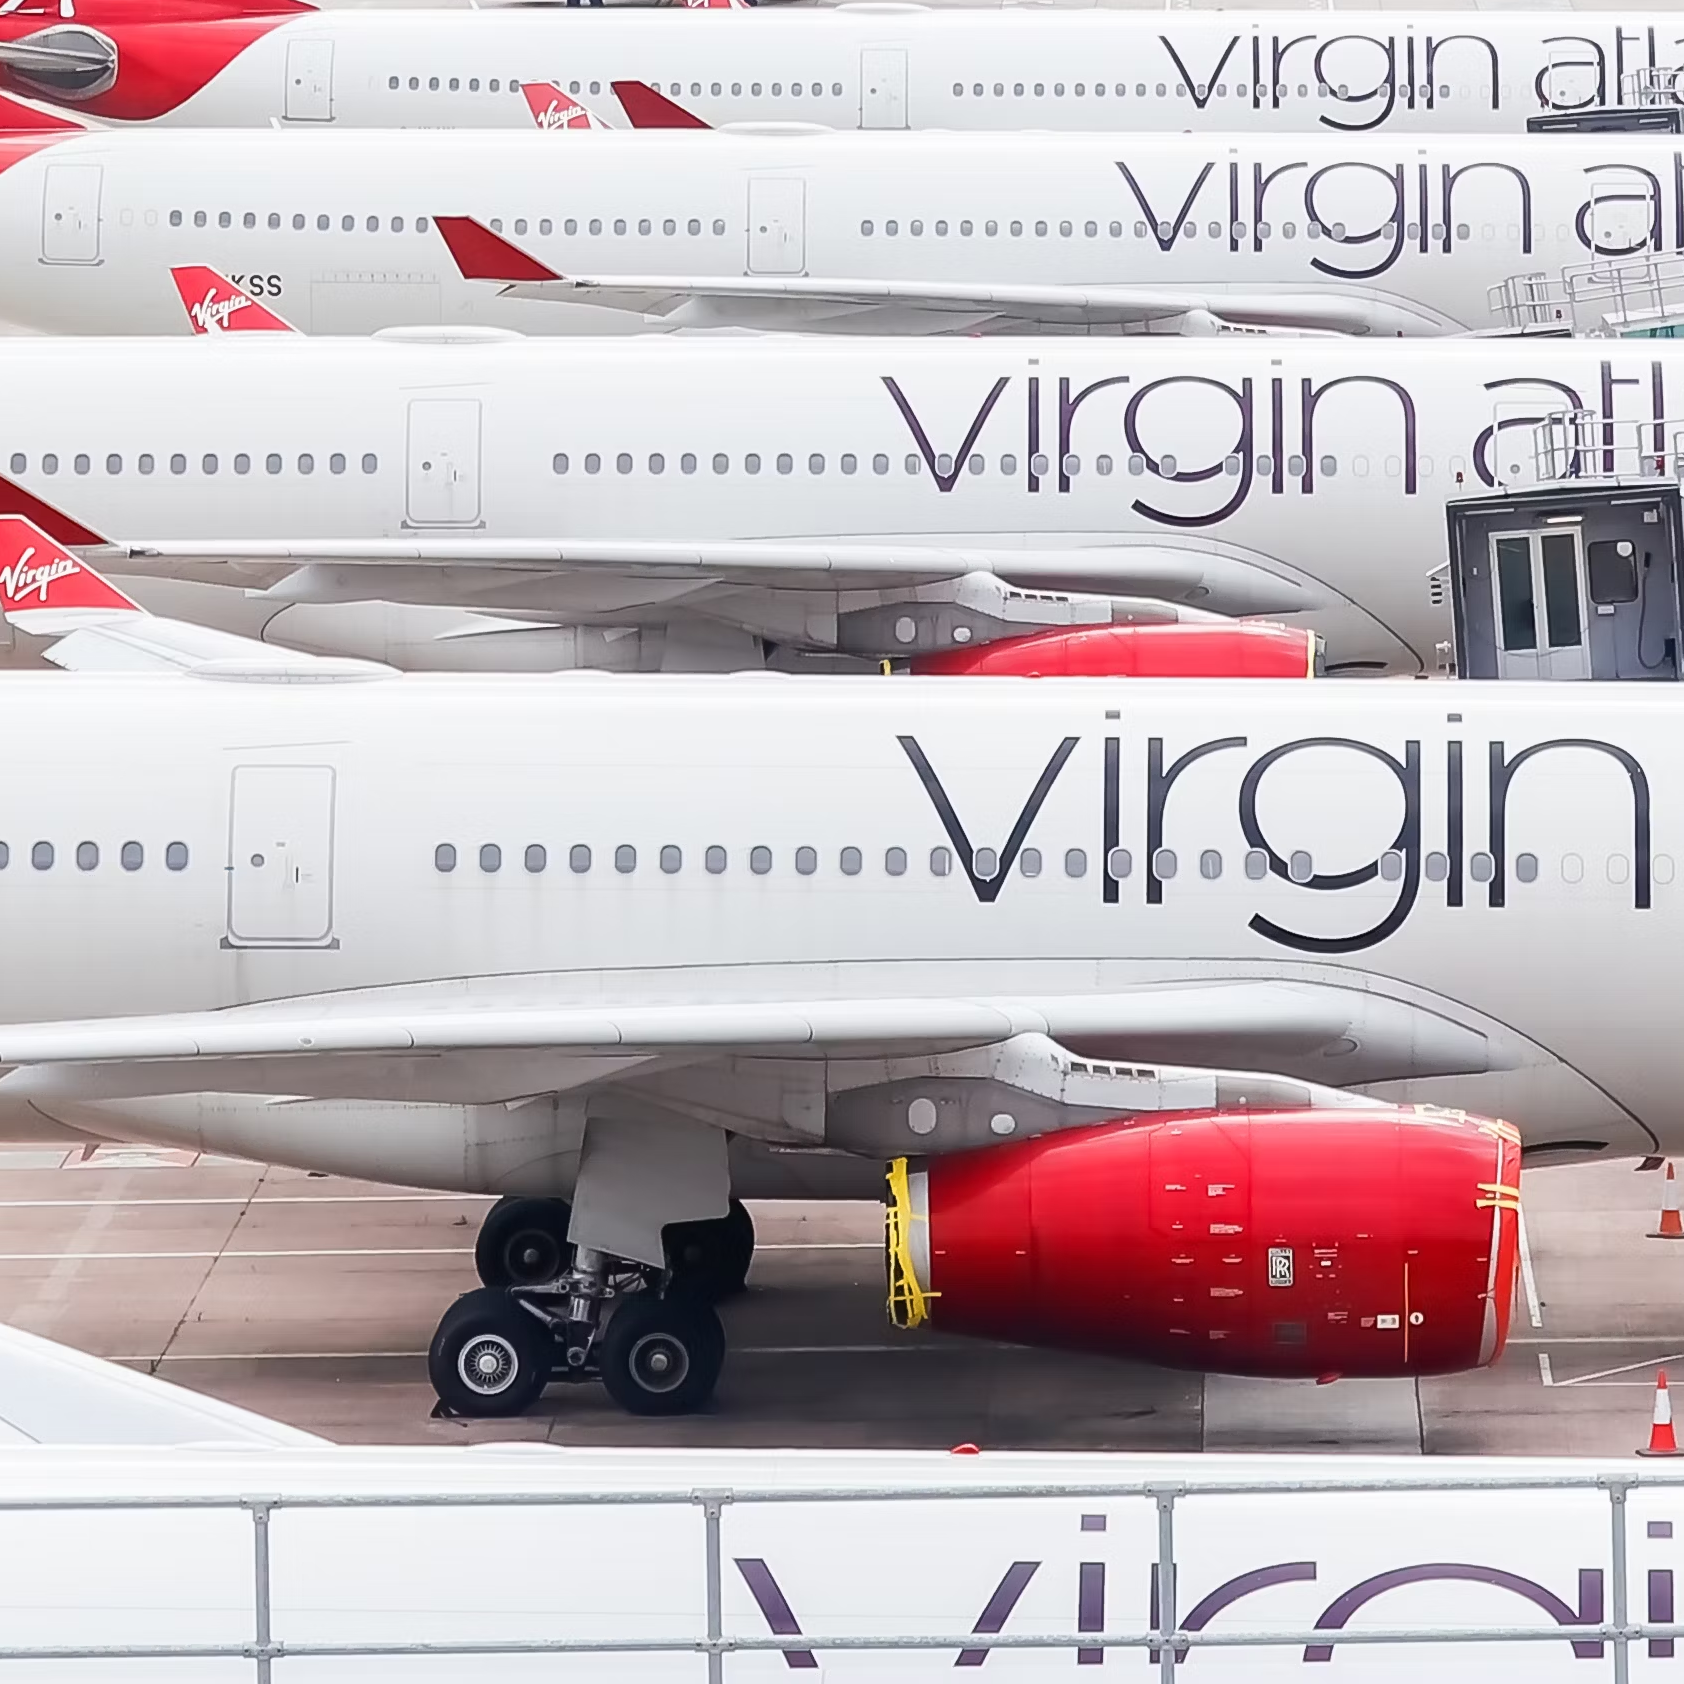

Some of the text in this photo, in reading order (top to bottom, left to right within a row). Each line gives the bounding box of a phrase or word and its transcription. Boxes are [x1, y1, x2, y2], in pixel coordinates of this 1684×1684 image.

[538, 100, 585, 130] Virgin
[1159, 24, 1499, 130] virgin
[1115, 148, 1532, 279] virgin
[191, 288, 252, 328] Virgin
[880, 358, 1417, 527] virgin
[0, 547, 81, 601] Virgin
[896, 708, 1651, 954] virgin
